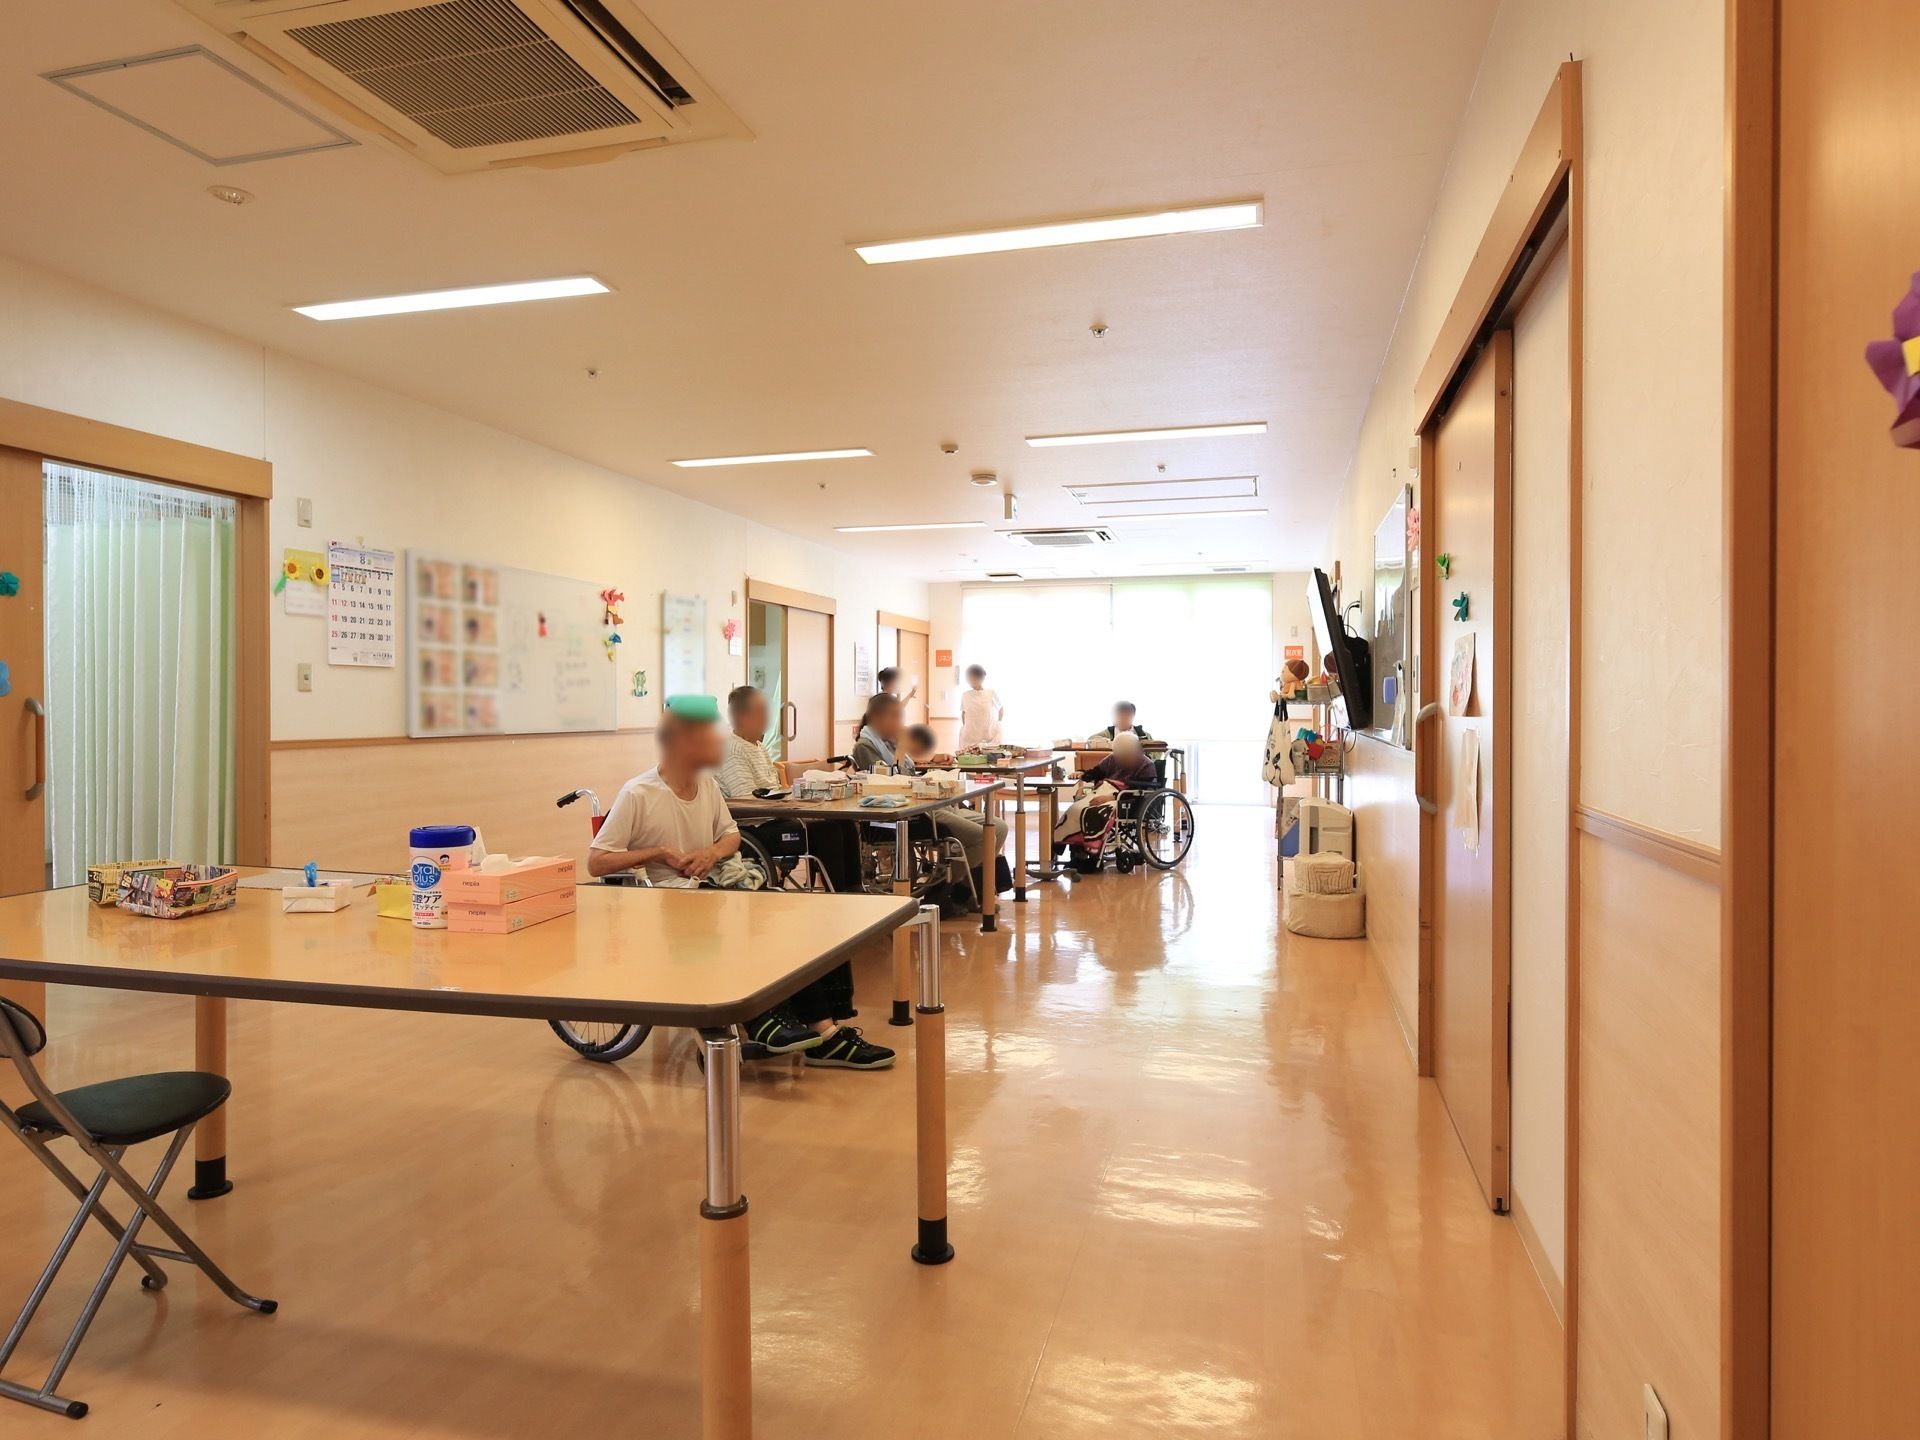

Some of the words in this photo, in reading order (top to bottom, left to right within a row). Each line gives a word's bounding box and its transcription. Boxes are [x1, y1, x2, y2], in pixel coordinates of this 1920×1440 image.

[350, 600, 357, 608] 13
[359, 601, 366, 609] 14
[368, 602, 374, 610] 15
[377, 603, 384, 611] 16
[331, 614, 338, 622] 18
[341, 615, 348, 623] 19
[350, 616, 357, 624] 20
[385, 619, 392, 627] 24
[331, 630, 338, 638] 25
[341, 631, 348, 639] 26
[350, 631, 357, 639] 27
[359, 632, 366, 640] 28
[368, 633, 375, 641] 29
[412, 863, 435, 875] Oral
[557, 865, 573, 873] nepia
[413, 874, 435, 884] plus
[559, 890, 574, 899] nepia
